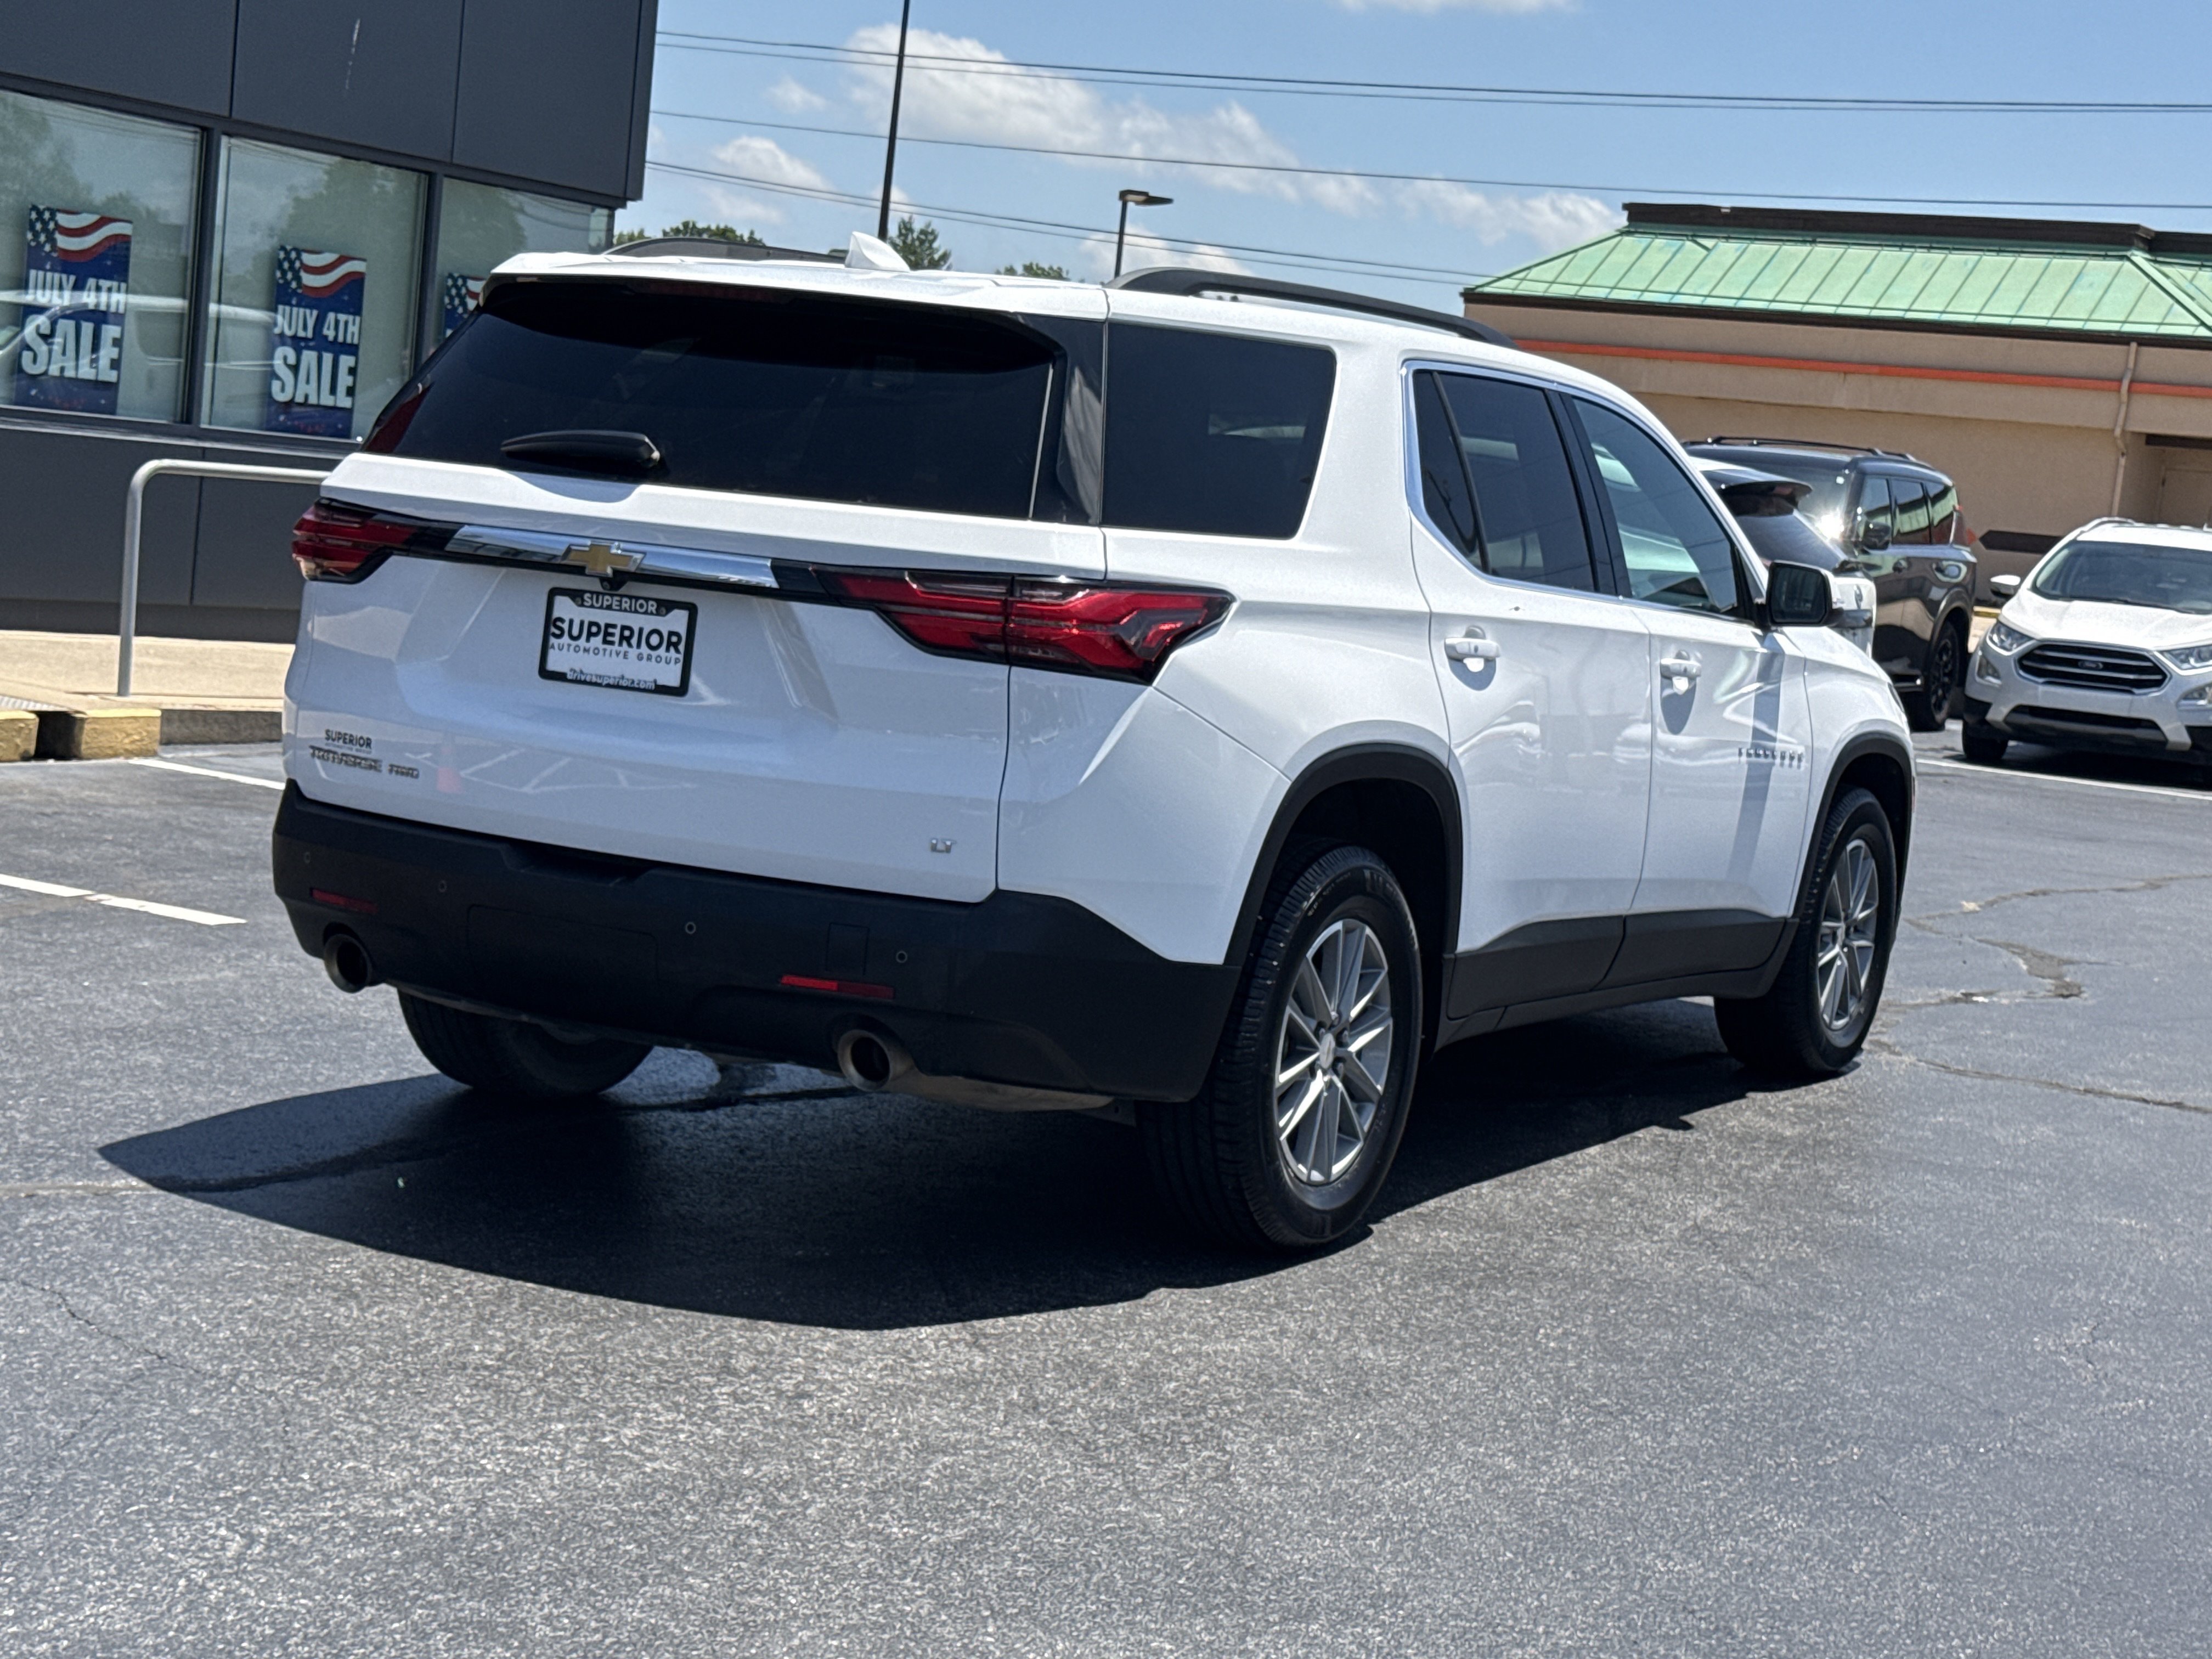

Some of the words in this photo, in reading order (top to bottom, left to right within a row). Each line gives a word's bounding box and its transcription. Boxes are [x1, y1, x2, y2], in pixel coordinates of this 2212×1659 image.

[26, 269, 76, 306] JULY
[83, 278, 127, 314] 4TH
[274, 304, 319, 339] JULY
[323, 312, 361, 345] 4TH
[21, 314, 122, 383] SALE
[271, 346, 356, 409] SALE
[583, 592, 657, 614] SUPERIOR
[549, 642, 629, 659] AUTOMOTIVE
[637, 652, 681, 666] GROUP
[550, 617, 683, 654] SUPERIOR
[325, 729, 372, 749] SUPERIOR
